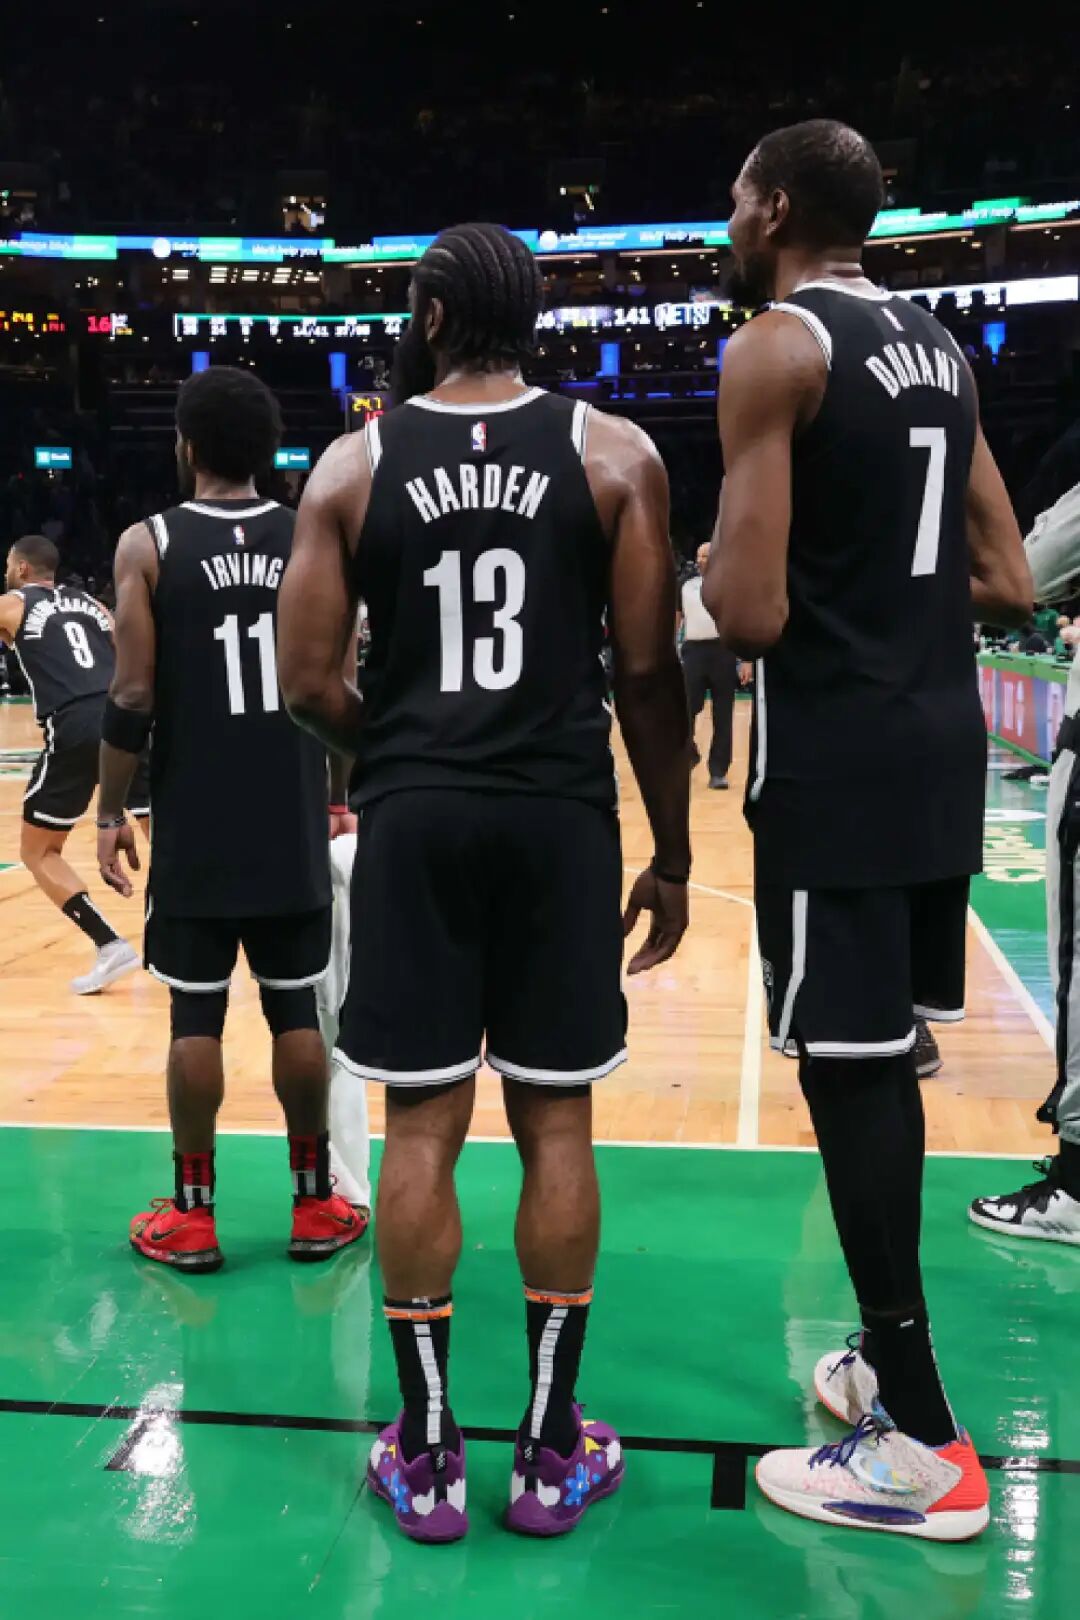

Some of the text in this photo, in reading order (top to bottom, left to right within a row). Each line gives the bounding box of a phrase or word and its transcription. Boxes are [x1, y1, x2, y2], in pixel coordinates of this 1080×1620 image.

[614, 306, 651, 326] 141
[864, 341, 960, 399] DURANT
[405, 463, 551, 523] HARDEN
[908, 427, 947, 577] 7
[201, 552, 284, 591] IRVING
[62, 621, 95, 669] 9
[423, 547, 526, 693] 13
[213, 612, 280, 715] 11
